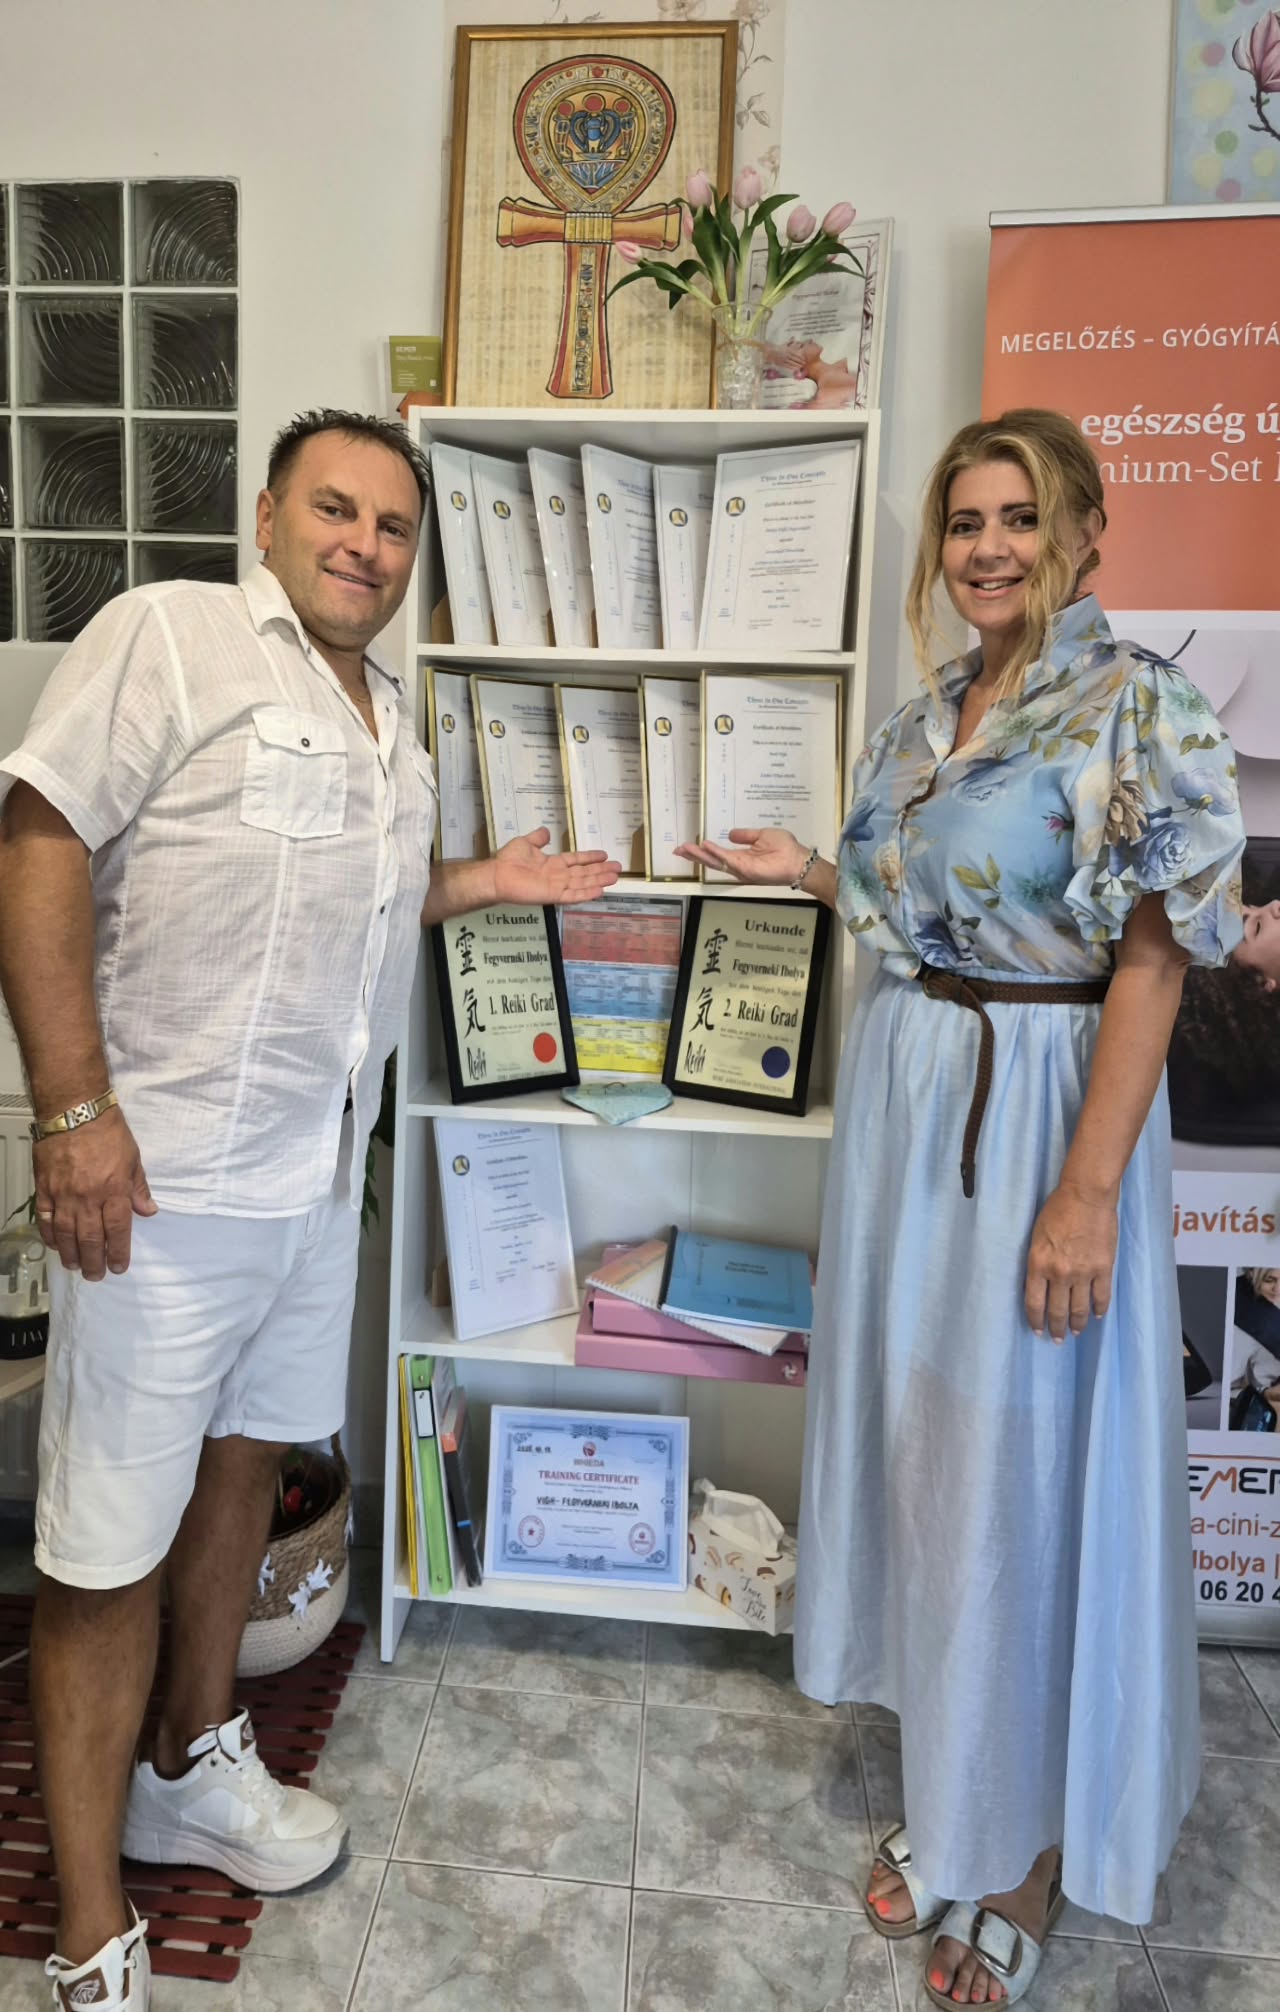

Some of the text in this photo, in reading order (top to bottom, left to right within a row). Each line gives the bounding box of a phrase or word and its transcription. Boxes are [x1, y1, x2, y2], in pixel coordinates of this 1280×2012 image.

[1001, 325, 1136, 354] MEGELŐZÉS
[1162, 321, 1280, 348] GYÓGYÍTÁ
[1081, 404, 1246, 445] egészség
[486, 914, 540, 926] Urkunde
[745, 919, 806, 937] Urkunde
[502, 994, 527, 1015] Reiki
[531, 992, 556, 1013] Grad
[737, 1000, 766, 1023] Reiki
[770, 1004, 799, 1028] Grad
[1173, 1203, 1276, 1238] javítás
[539, 1470, 640, 1486] TRAINING CERTIFICATE
[1200, 1580, 1228, 1601] 06
[1235, 1581, 1264, 1603] 20
